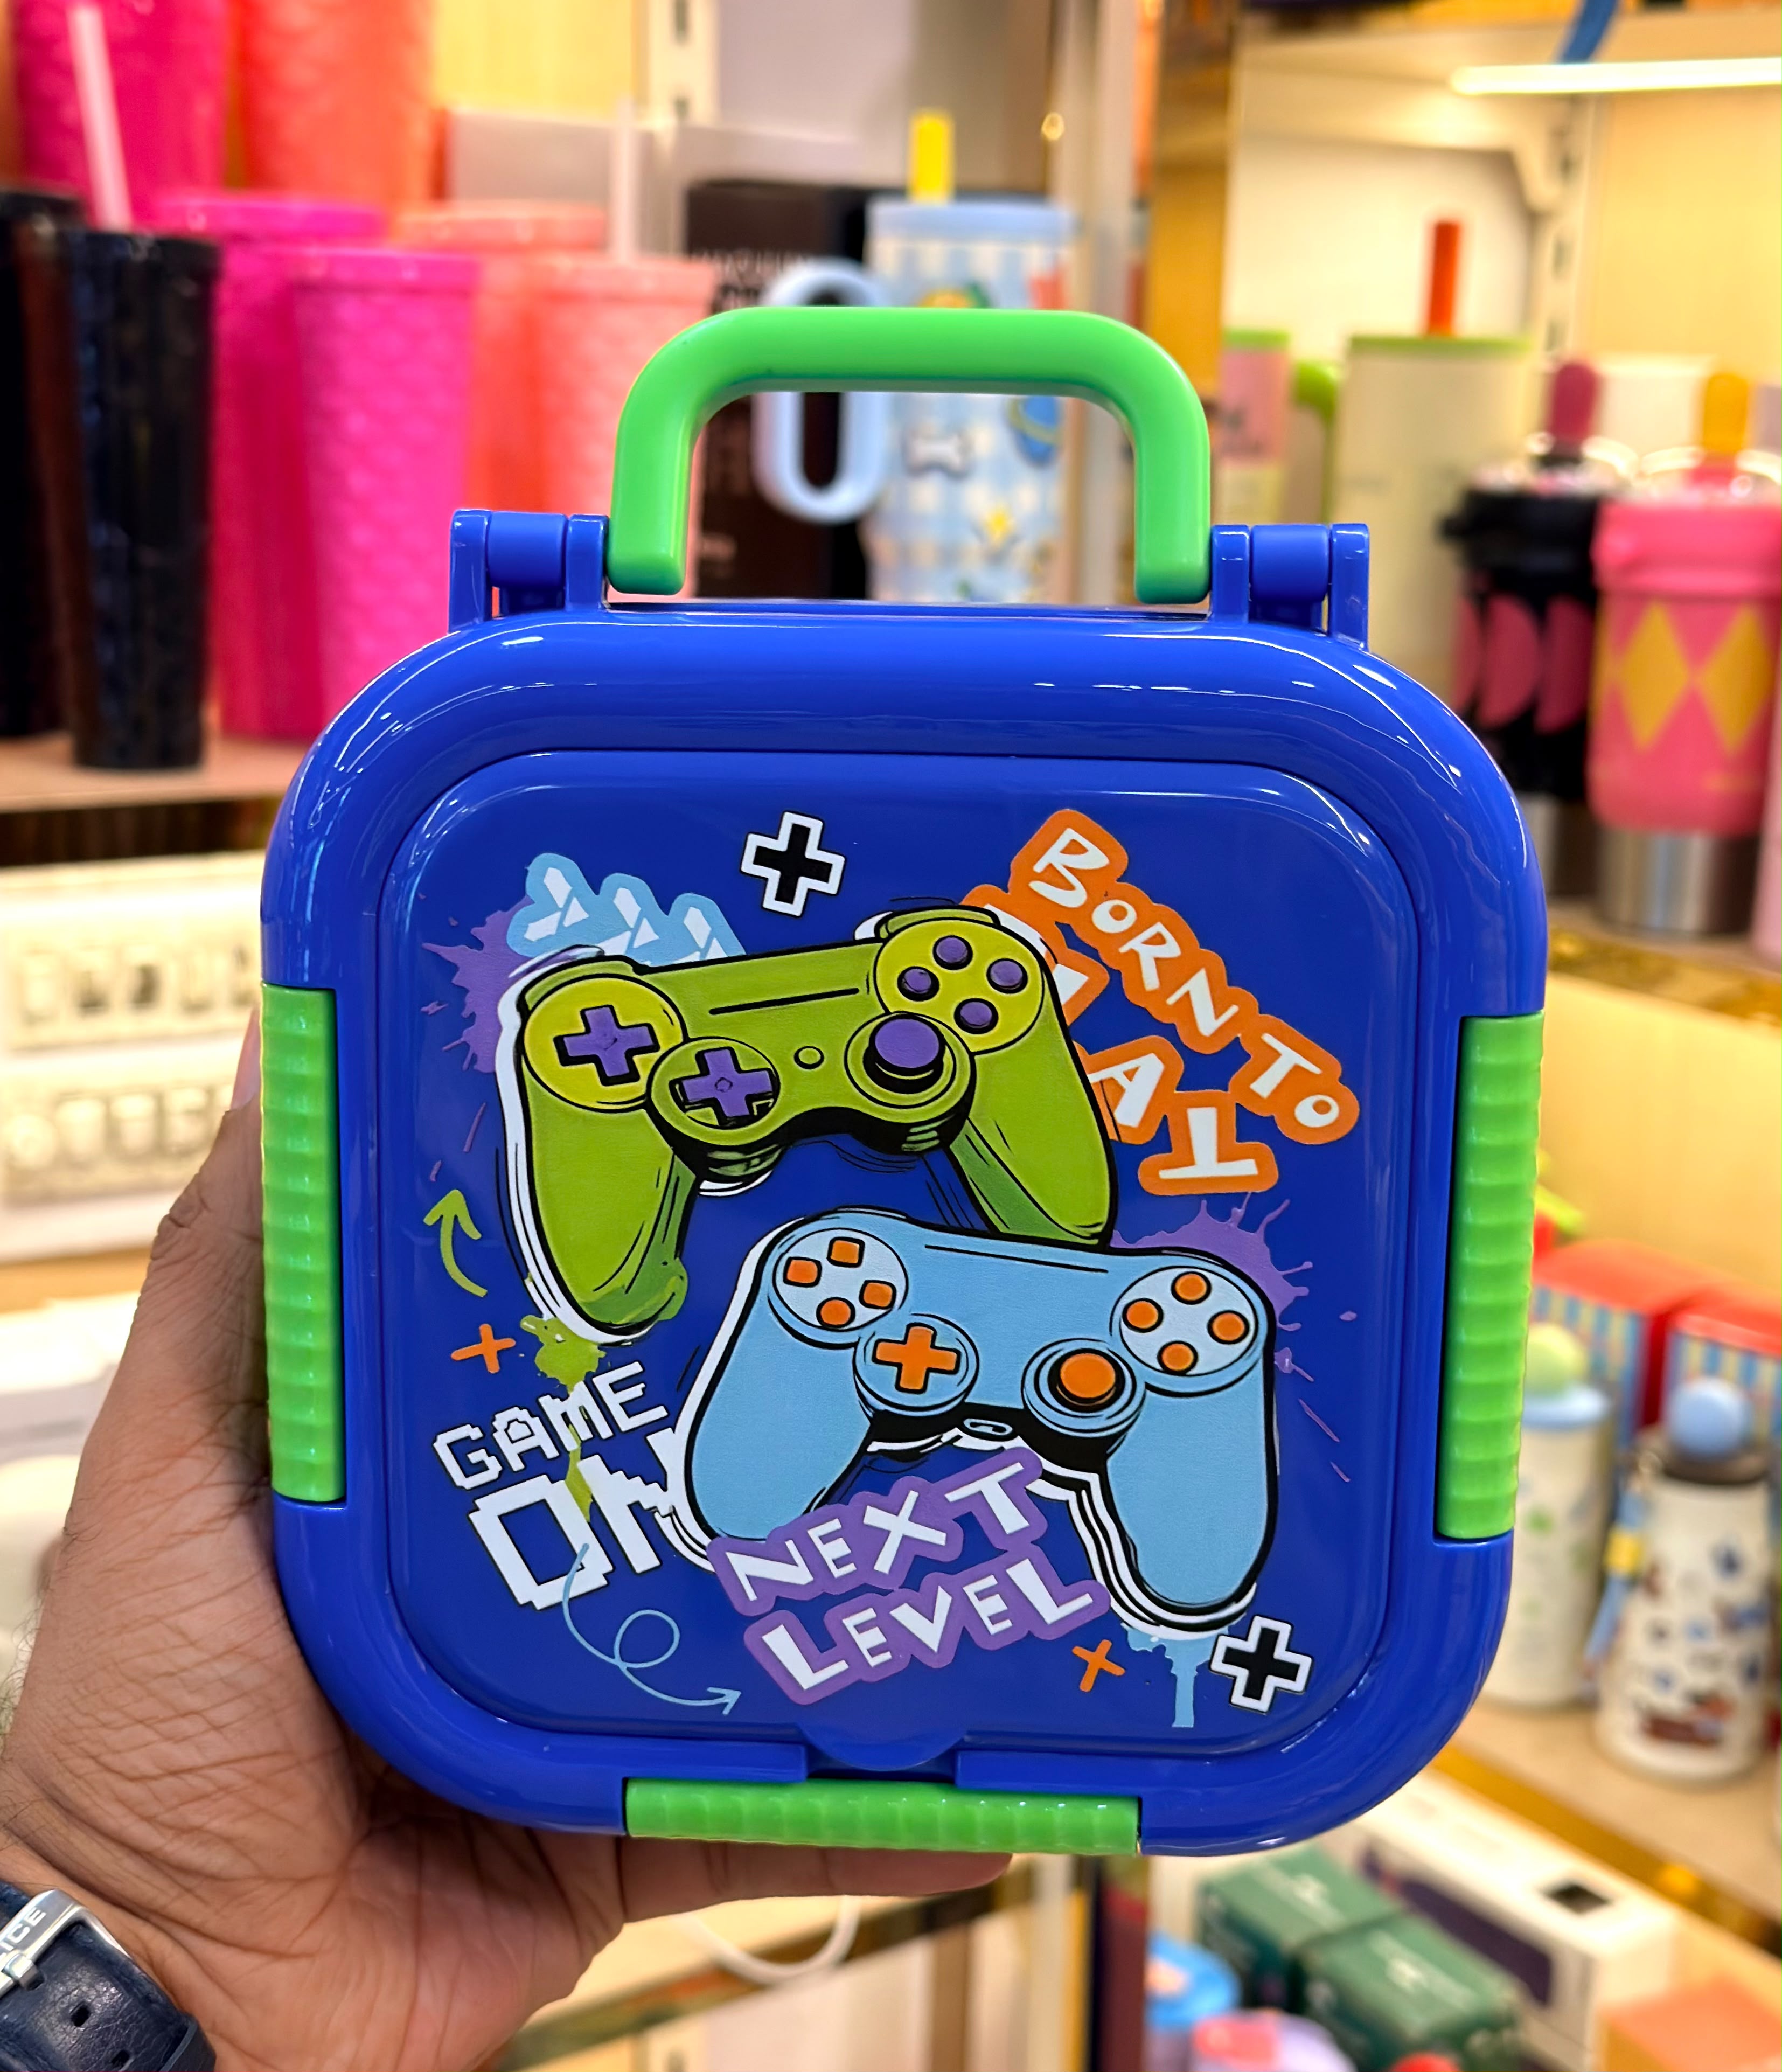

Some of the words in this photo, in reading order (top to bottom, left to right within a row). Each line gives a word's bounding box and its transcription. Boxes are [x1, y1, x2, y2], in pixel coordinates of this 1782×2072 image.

[984, 903, 1258, 1179] AY
[1029, 828, 1239, 1036] BORN
[1250, 1033, 1340, 1128] TO
[433, 1361, 669, 1490] GAME
[468, 1428, 679, 1610] ON
[726, 1462, 1031, 1601] NEXT
[761, 1558, 1093, 1690] LEVEL
[0, 1907, 47, 1957] ICE
